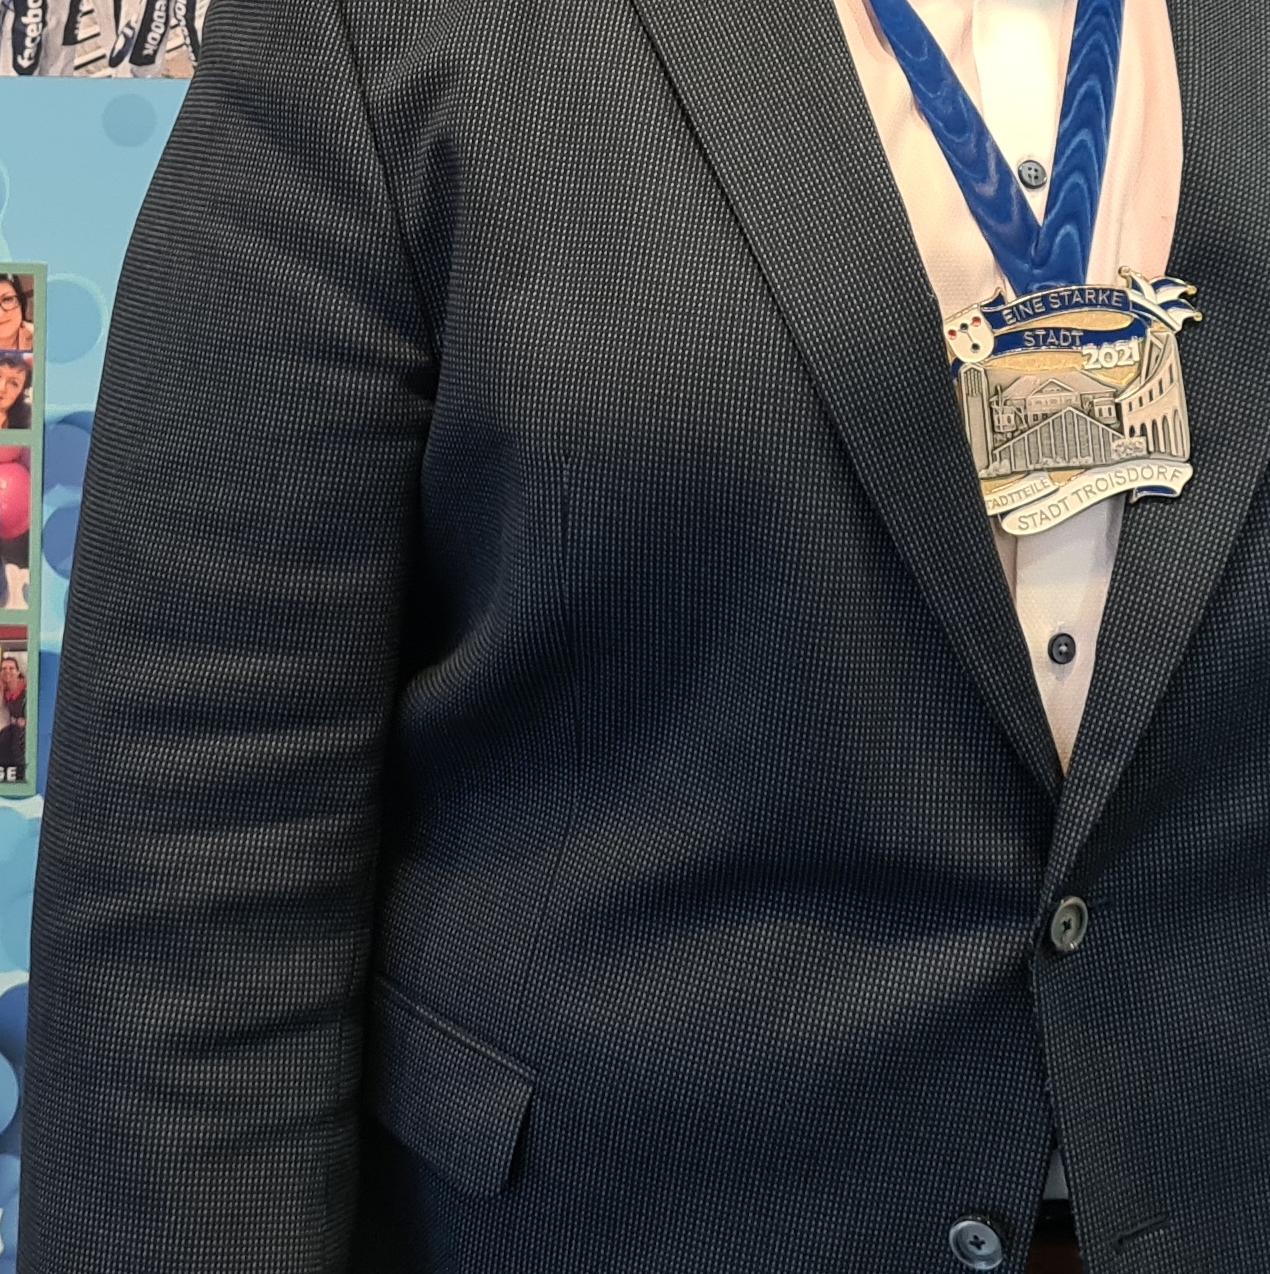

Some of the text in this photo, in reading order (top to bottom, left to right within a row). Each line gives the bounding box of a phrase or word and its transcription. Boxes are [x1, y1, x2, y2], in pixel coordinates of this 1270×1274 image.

[1002, 289, 1125, 326] EINE STARKE
[1023, 329, 1085, 347] STADT
[1082, 337, 1142, 371] 2021
[986, 477, 1051, 511] TADTTEILE
[1017, 464, 1184, 531] STADT TROISDORF
